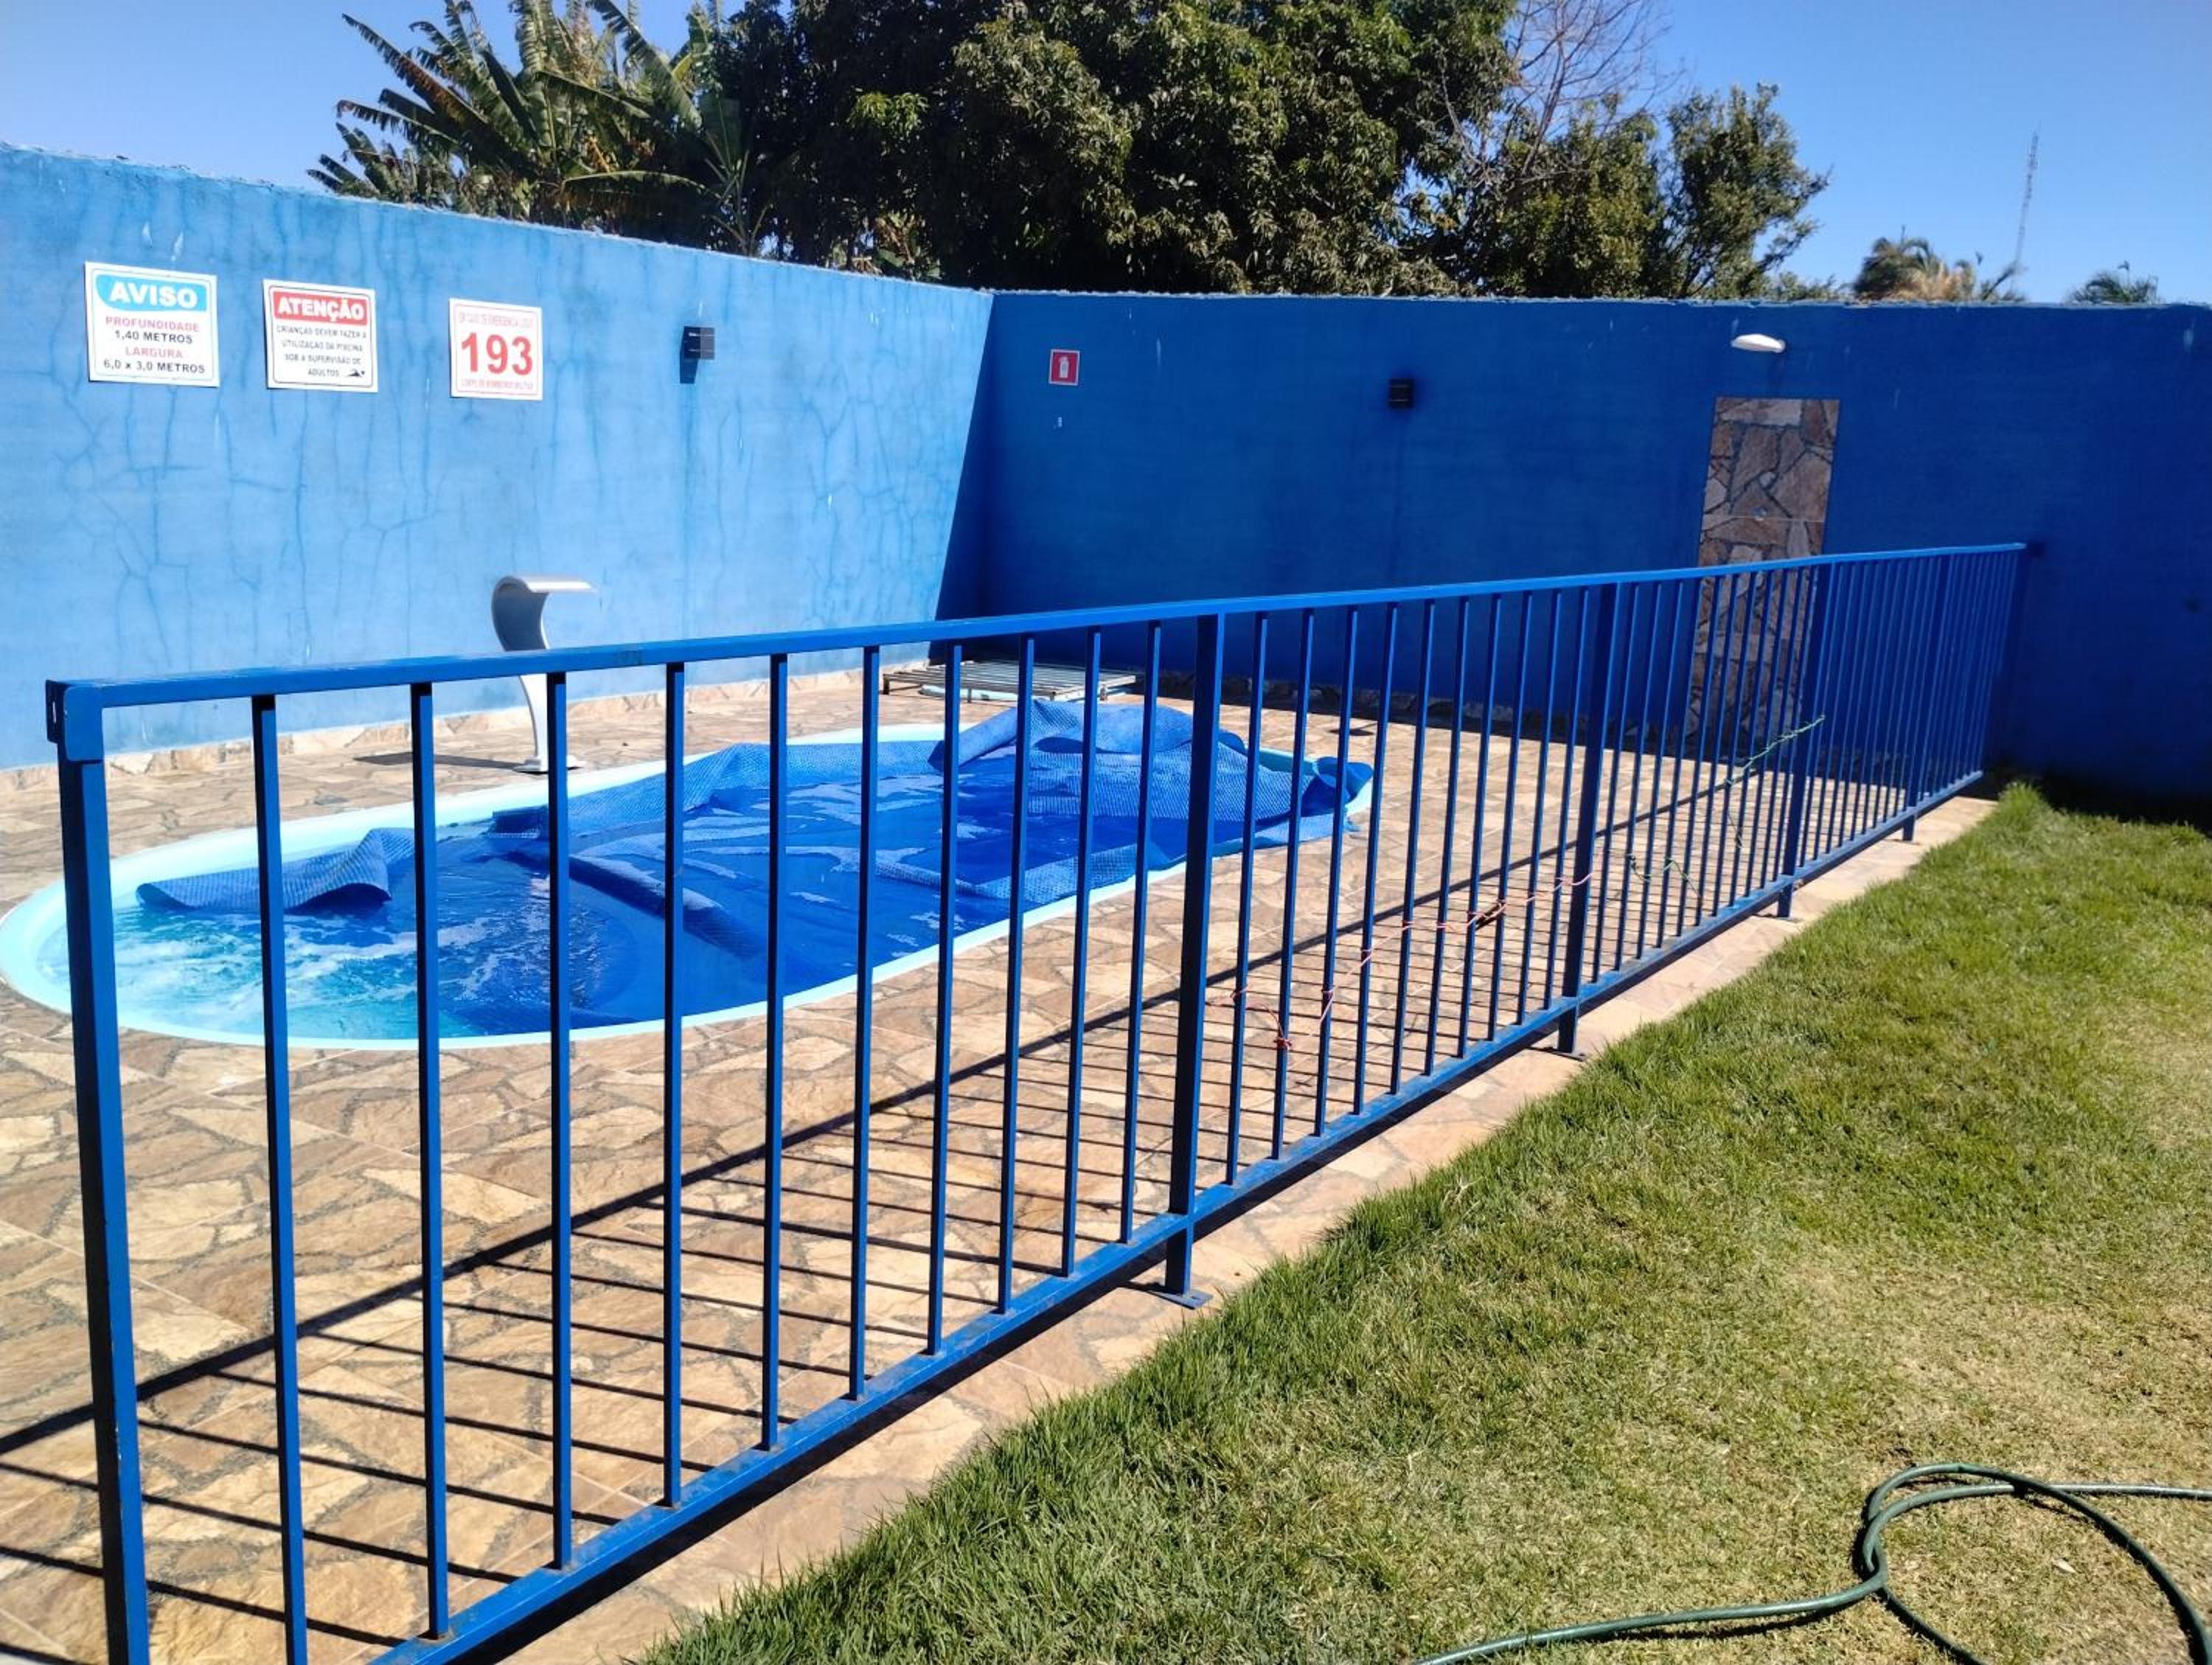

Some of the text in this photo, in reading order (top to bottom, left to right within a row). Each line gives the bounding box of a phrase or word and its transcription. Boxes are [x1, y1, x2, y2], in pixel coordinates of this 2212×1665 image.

[109, 280, 198, 308] AVISO
[278, 296, 364, 322] ATENÇÃO
[105, 316, 200, 332] PROFUNDIDADE
[115, 330, 192, 344] 1,40 METROS
[276, 325, 313, 336] CRIANÇAS
[340, 330, 360, 338] FAZER
[125, 347, 183, 359] LARGURA
[336, 343, 363, 352] PISCINA
[461, 332, 533, 376] 193
[103, 359, 122, 370] 6,0
[136, 361, 153, 371] 3,0
[157, 361, 206, 374] METROS
[307, 368, 340, 377] ADULTOS
